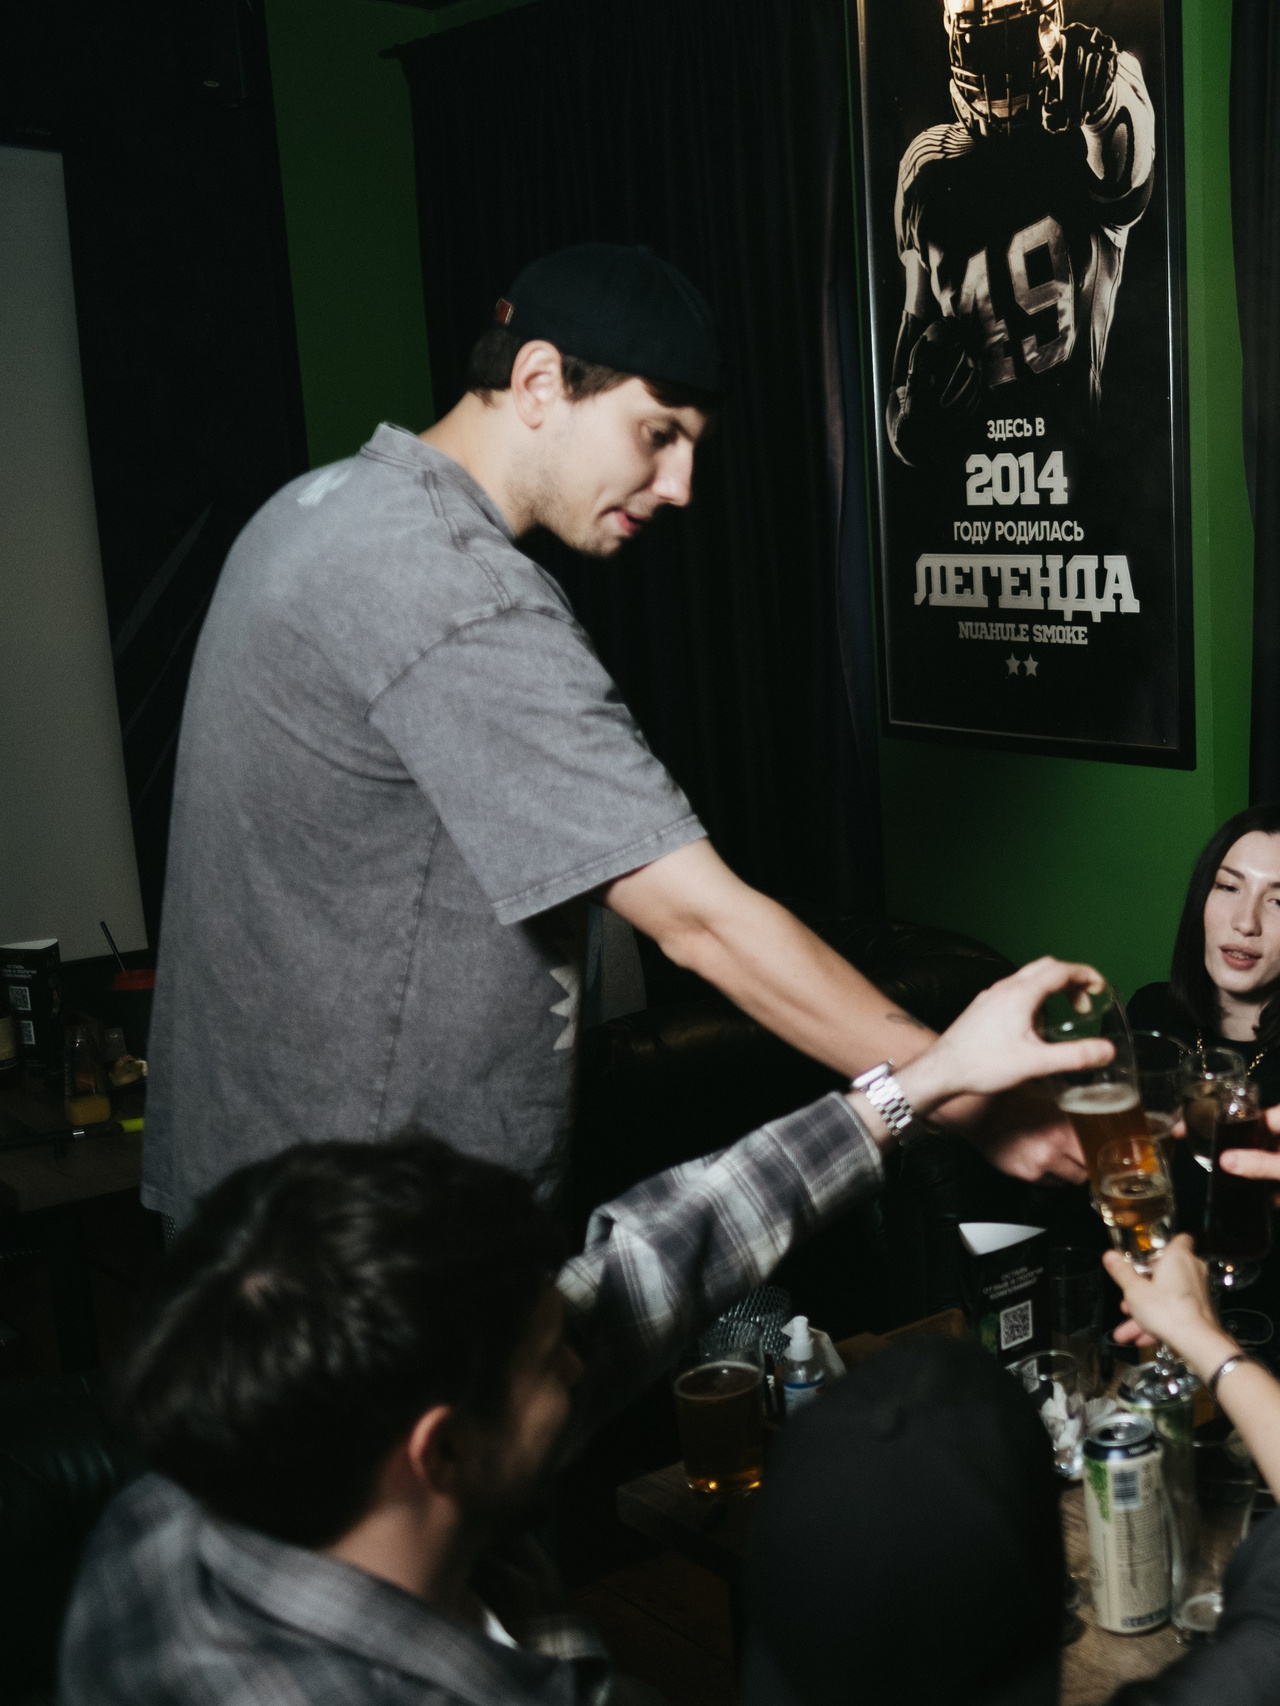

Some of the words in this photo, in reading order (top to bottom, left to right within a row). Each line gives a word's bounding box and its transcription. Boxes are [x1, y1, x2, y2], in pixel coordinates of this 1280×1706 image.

[986, 418, 1032, 442] ЗДЕСЬ
[1035, 417, 1045, 437] В
[965, 450, 1069, 506] 2014
[953, 520, 992, 545] ГОДУ
[995, 520, 1085, 545] РОДИЛАСЬ
[914, 553, 1141, 623] ЛЕГЕНДА
[958, 621, 1030, 643] NUAHULE
[1032, 624, 1089, 645] SMOKE
